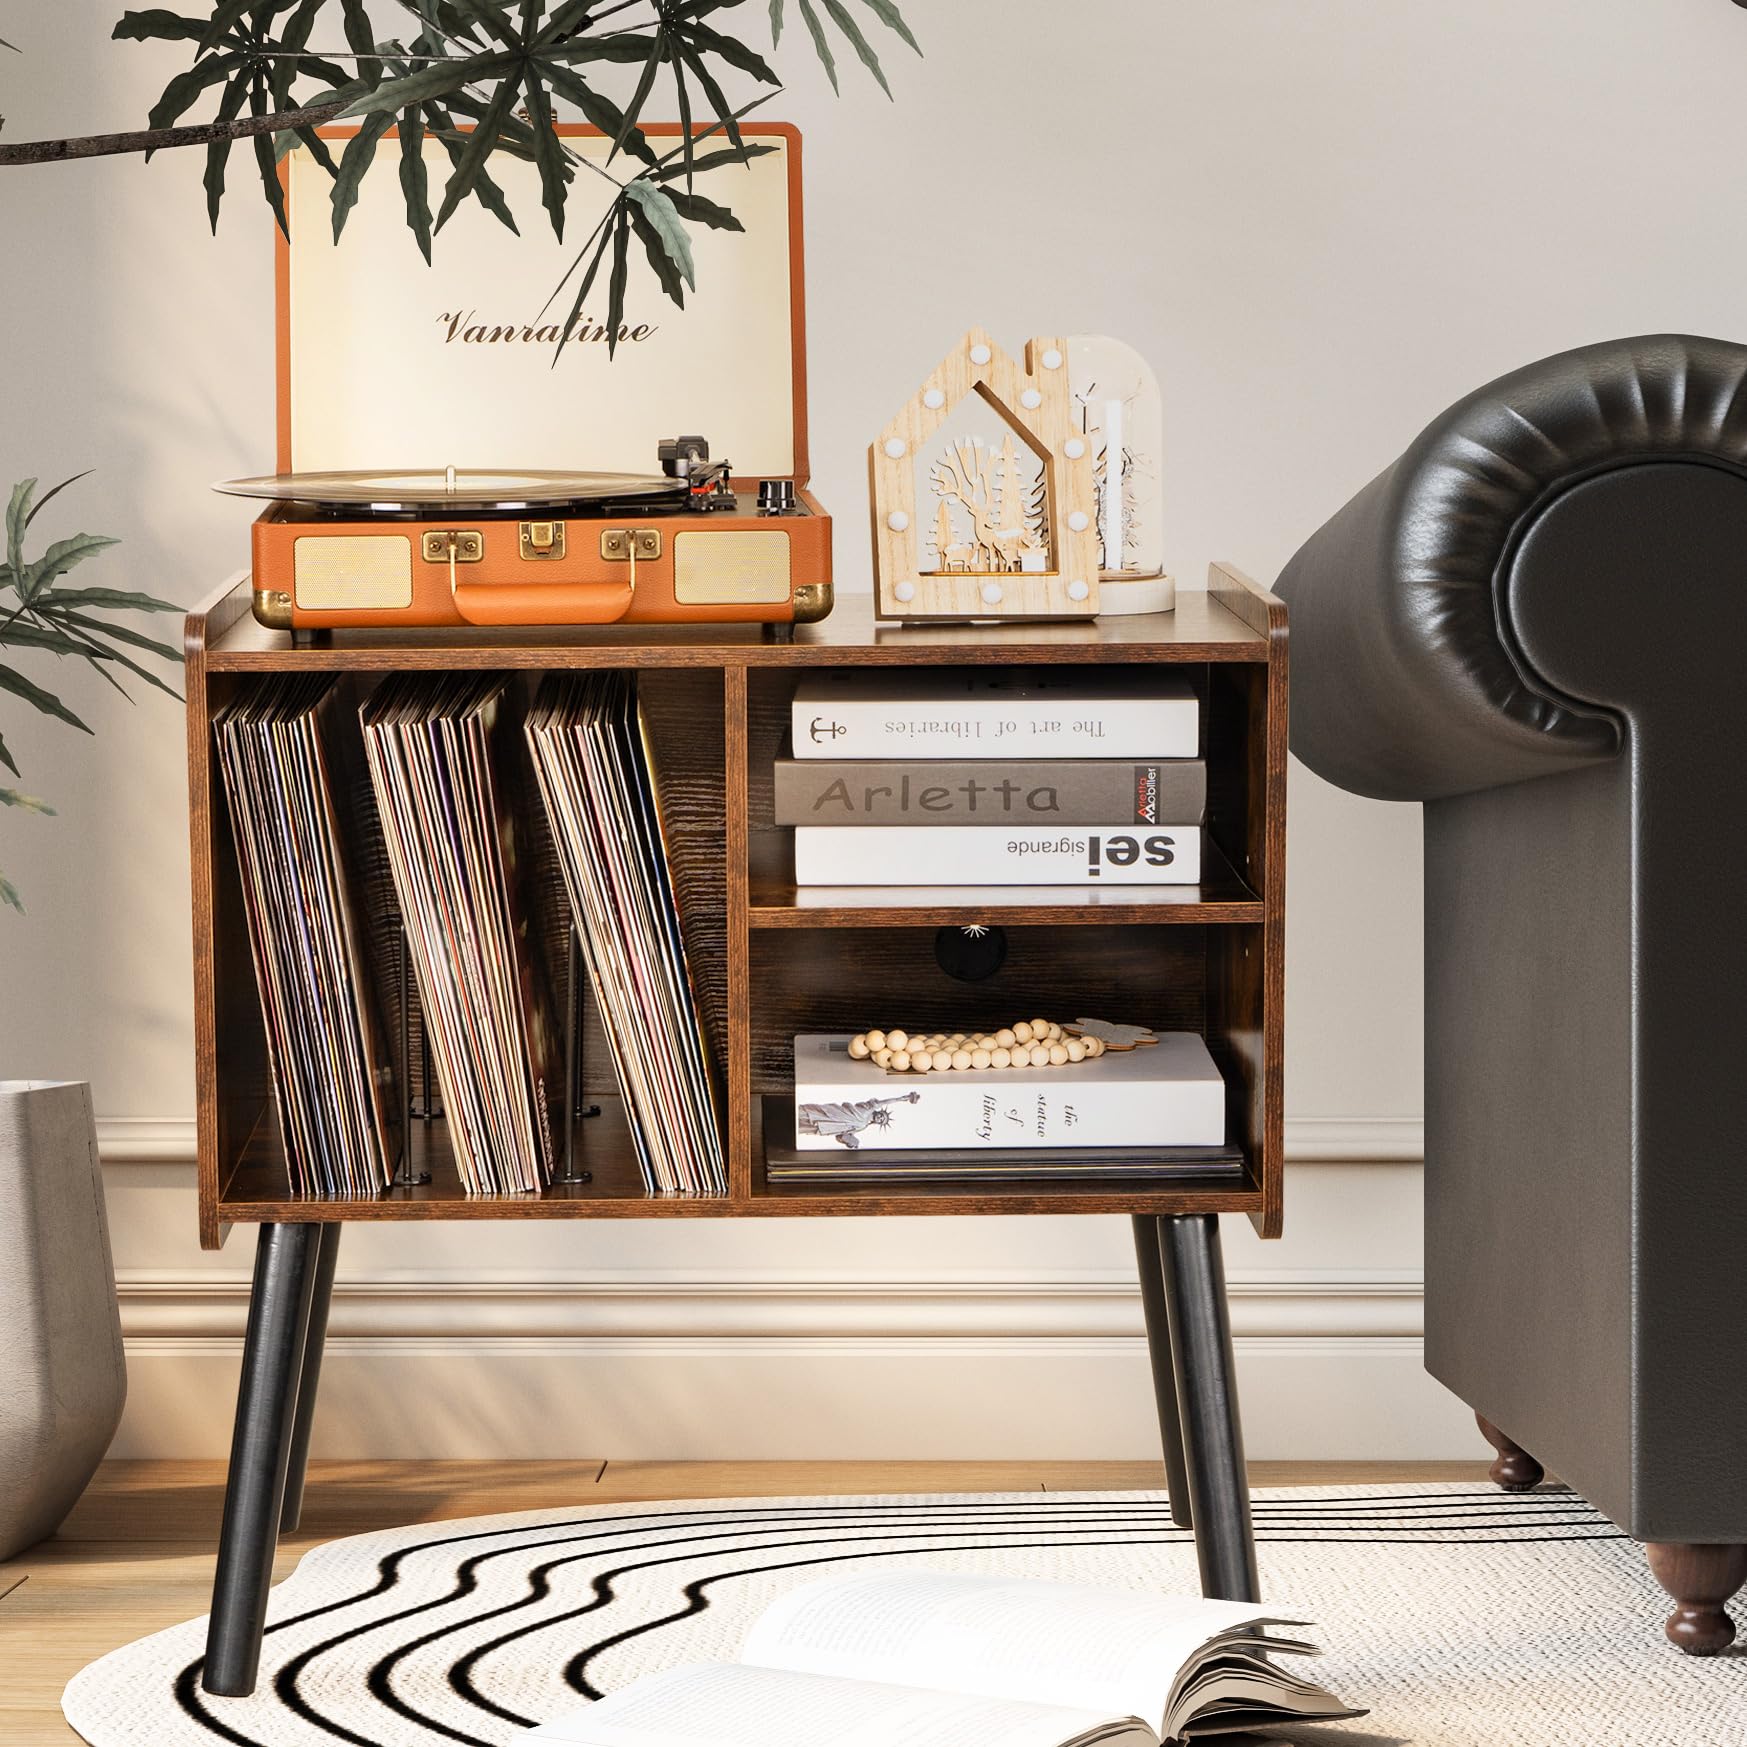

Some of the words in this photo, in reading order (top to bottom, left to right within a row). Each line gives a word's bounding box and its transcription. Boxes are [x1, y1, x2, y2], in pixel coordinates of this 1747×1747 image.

[884, 720, 981, 738] libraries
[994, 720, 1017, 738] of
[1031, 720, 1062, 738] art
[1073, 720, 1106, 738] The
[812, 774, 1061, 812] Arletta
[1145, 768, 1156, 825] Mobilier
[1007, 837, 1085, 858] sigrande
[1089, 835, 1176, 877] sei
[975, 1094, 997, 1141] liberty
[1004, 1108, 1024, 1128] of
[1036, 1093, 1047, 1138] statue
[1063, 1104, 1079, 1127] the
